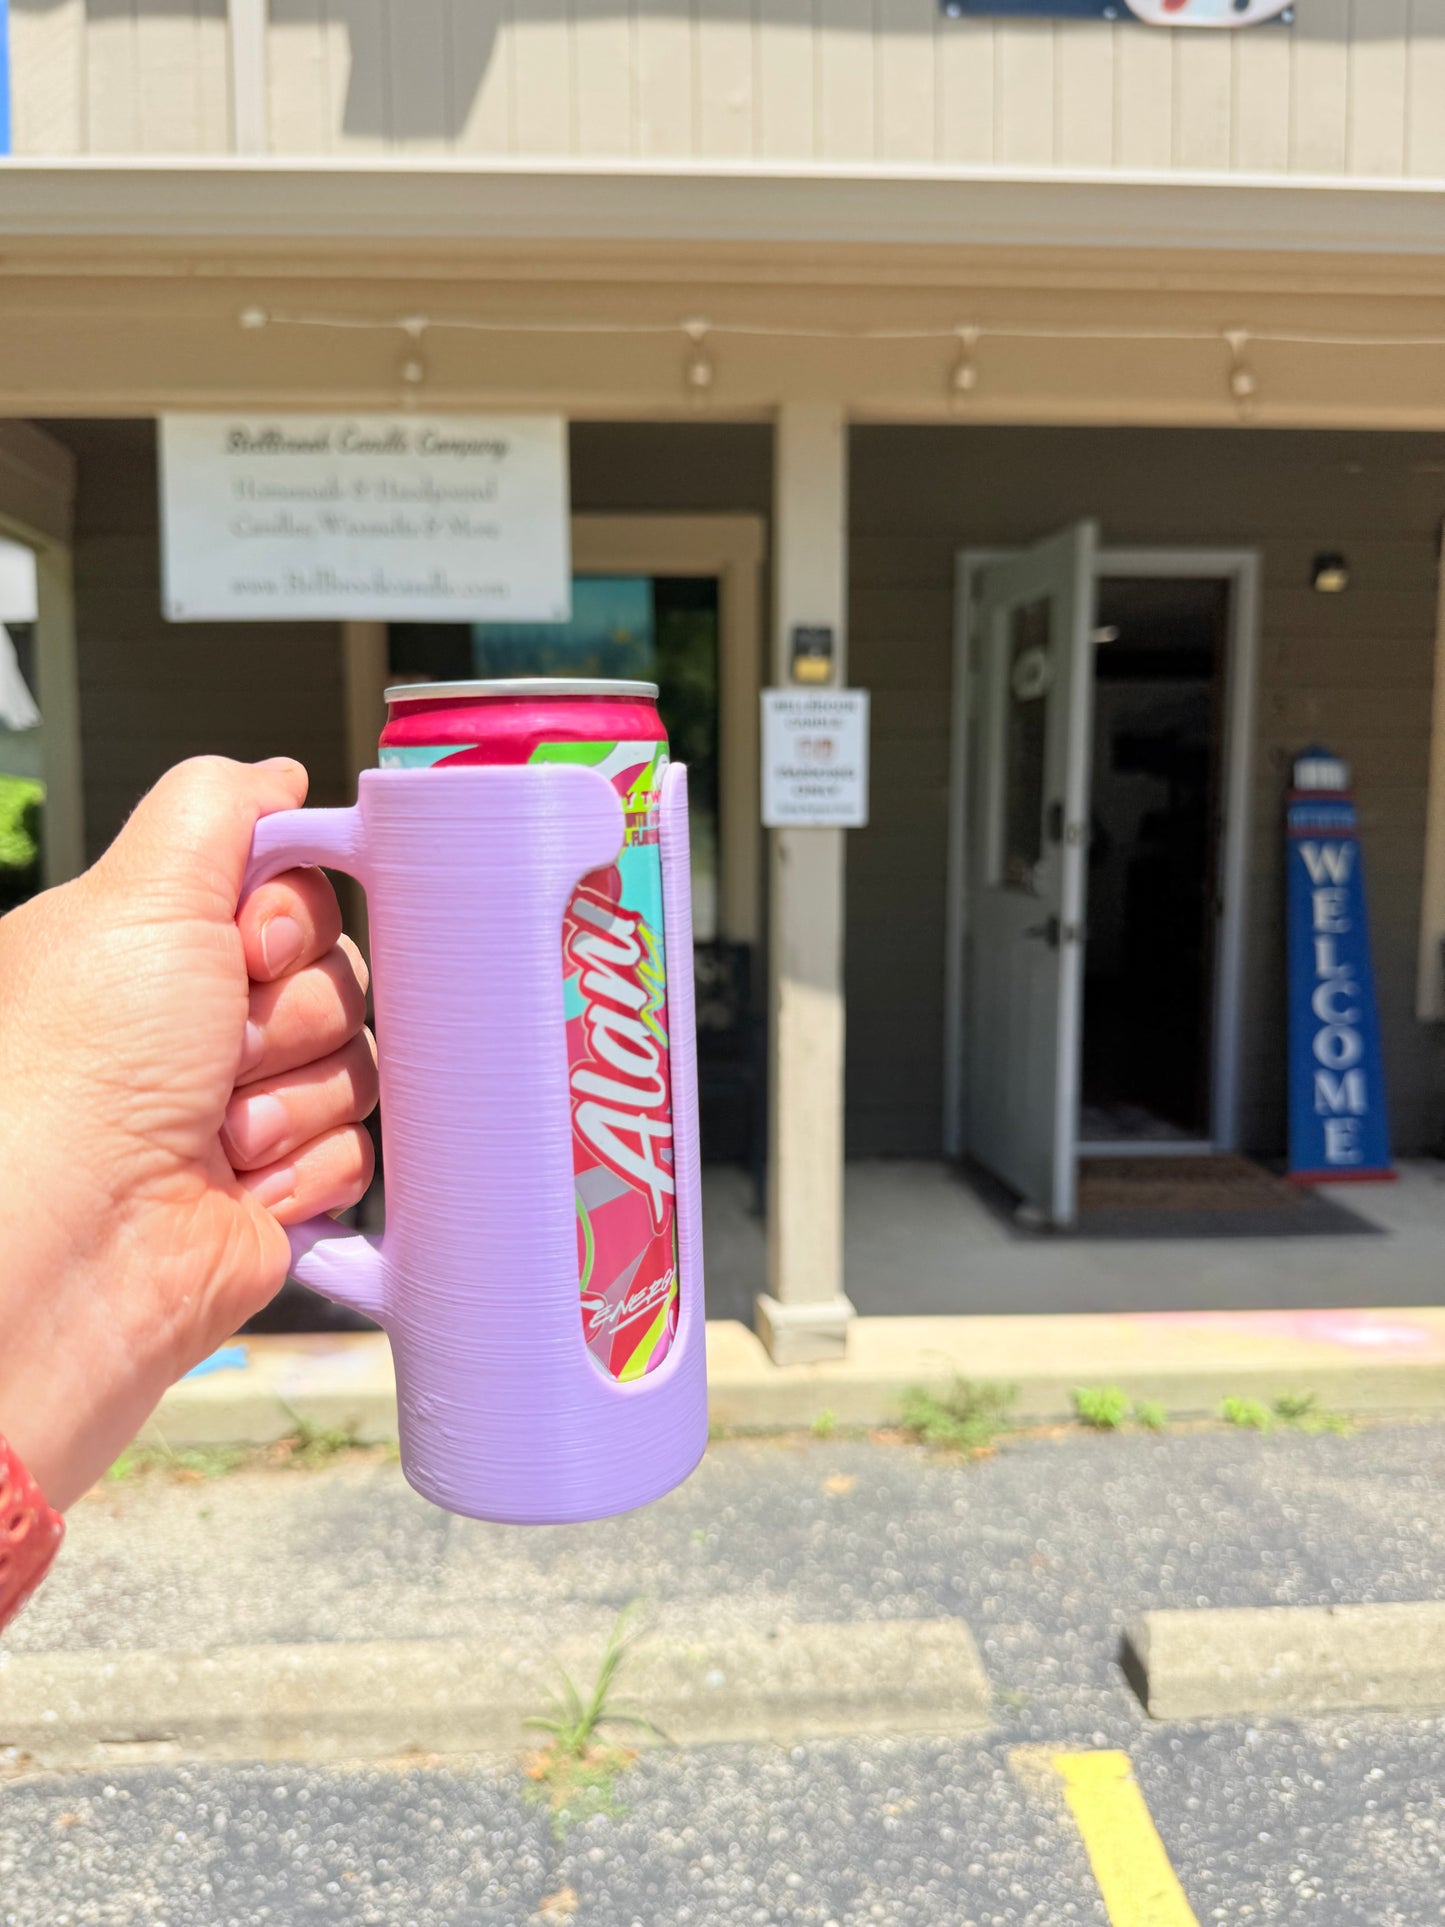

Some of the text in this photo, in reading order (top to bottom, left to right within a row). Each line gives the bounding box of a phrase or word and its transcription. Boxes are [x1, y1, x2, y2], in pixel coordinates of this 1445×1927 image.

[418, 427, 509, 460] Company
[571, 898, 674, 1224] Alani
[1300, 841, 1367, 1164] WELCOME
